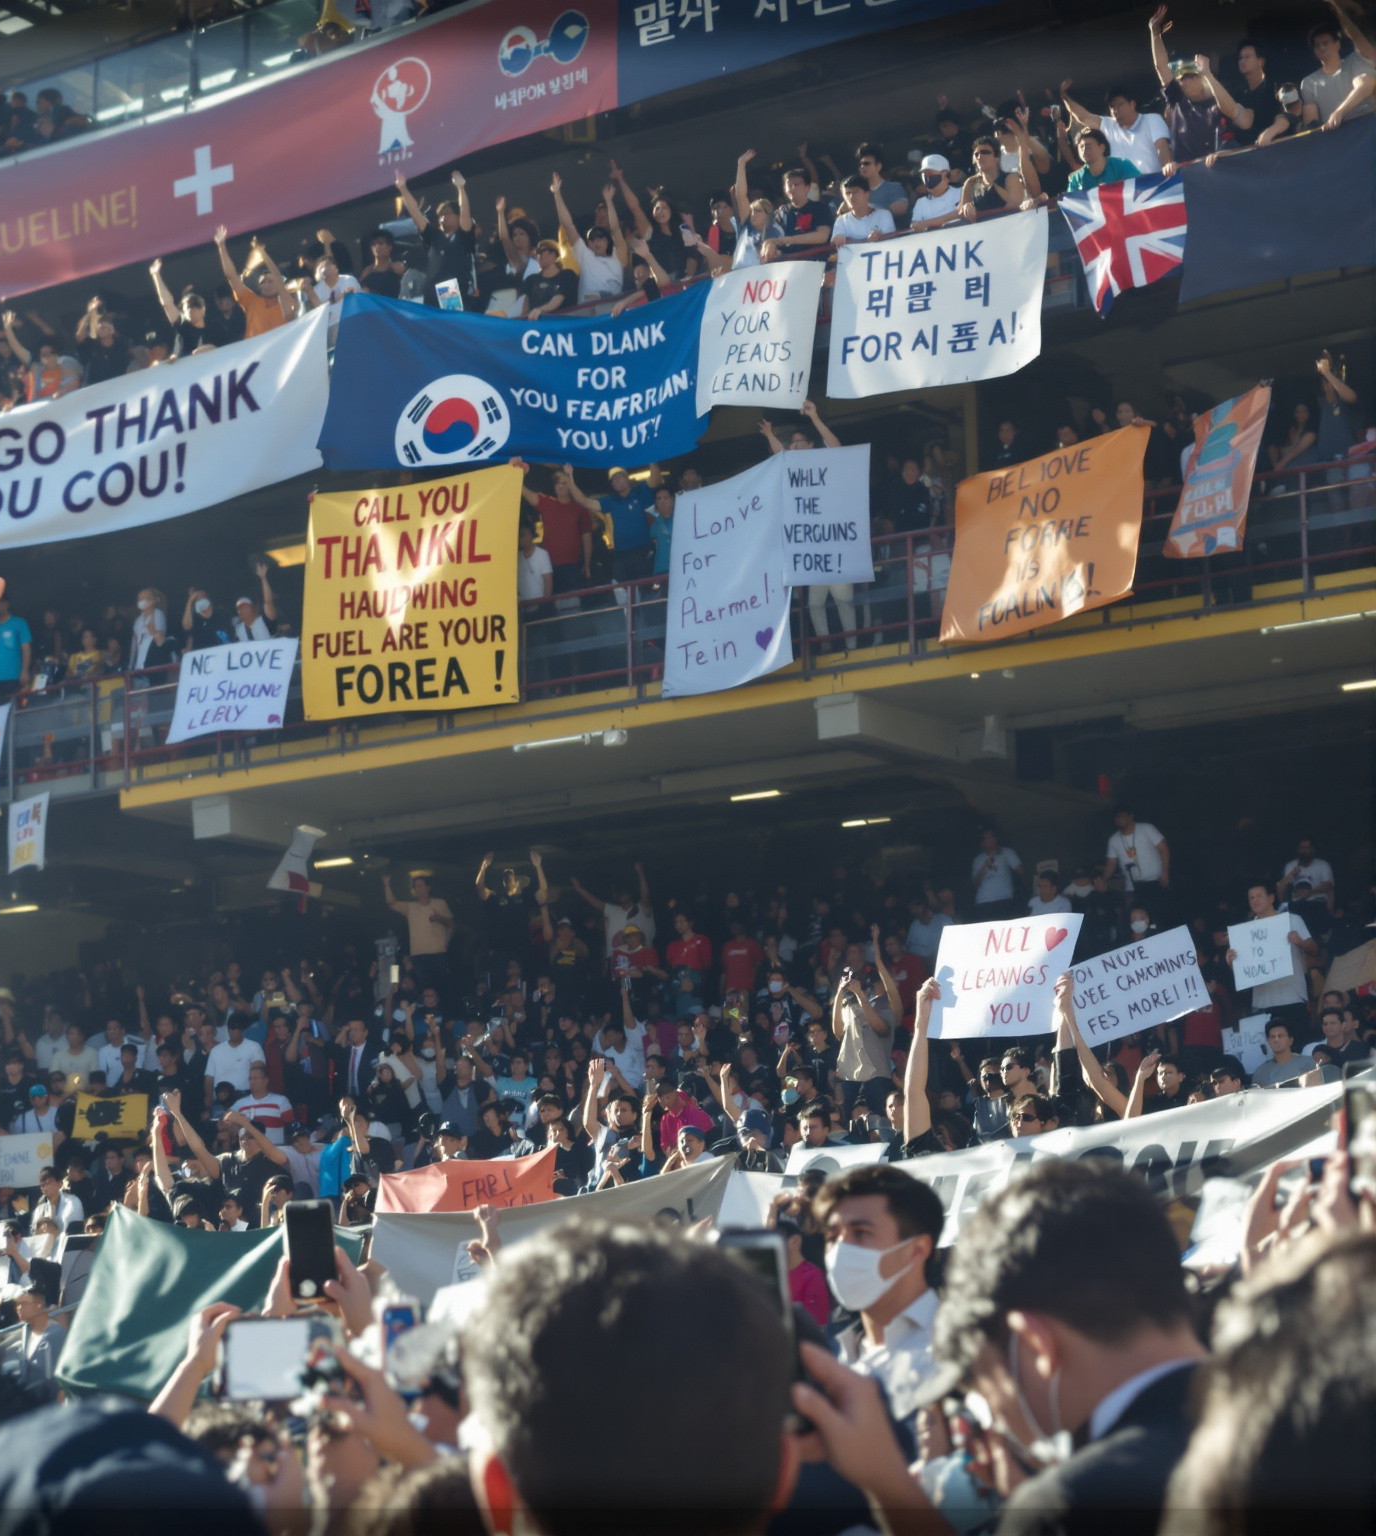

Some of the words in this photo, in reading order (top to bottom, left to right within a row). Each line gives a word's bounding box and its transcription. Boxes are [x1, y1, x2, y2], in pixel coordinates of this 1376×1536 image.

[860, 240, 985, 283] THANK
[742, 278, 788, 306] NOU
[590, 320, 666, 355] DLANK
[720, 310, 771, 338] YOUR
[841, 331, 902, 365] FOR
[577, 365, 627, 390] FOR
[712, 371, 782, 396] LEAND
[85, 361, 262, 455] THANK
[509, 387, 559, 414] YOU
[62, 442, 187, 514] COU!
[354, 493, 410, 527] CALL
[418, 482, 470, 518] YOU
[795, 496, 822, 516] THE
[1017, 487, 1061, 521] NO
[312, 629, 372, 660] FUEL
[381, 621, 429, 653] ARE
[439, 614, 507, 648] YOUR
[226, 648, 284, 671] LOVE
[335, 656, 470, 707] FOREA
[989, 1002, 1031, 1027] YOU
[1087, 1009, 1121, 1035] FES
